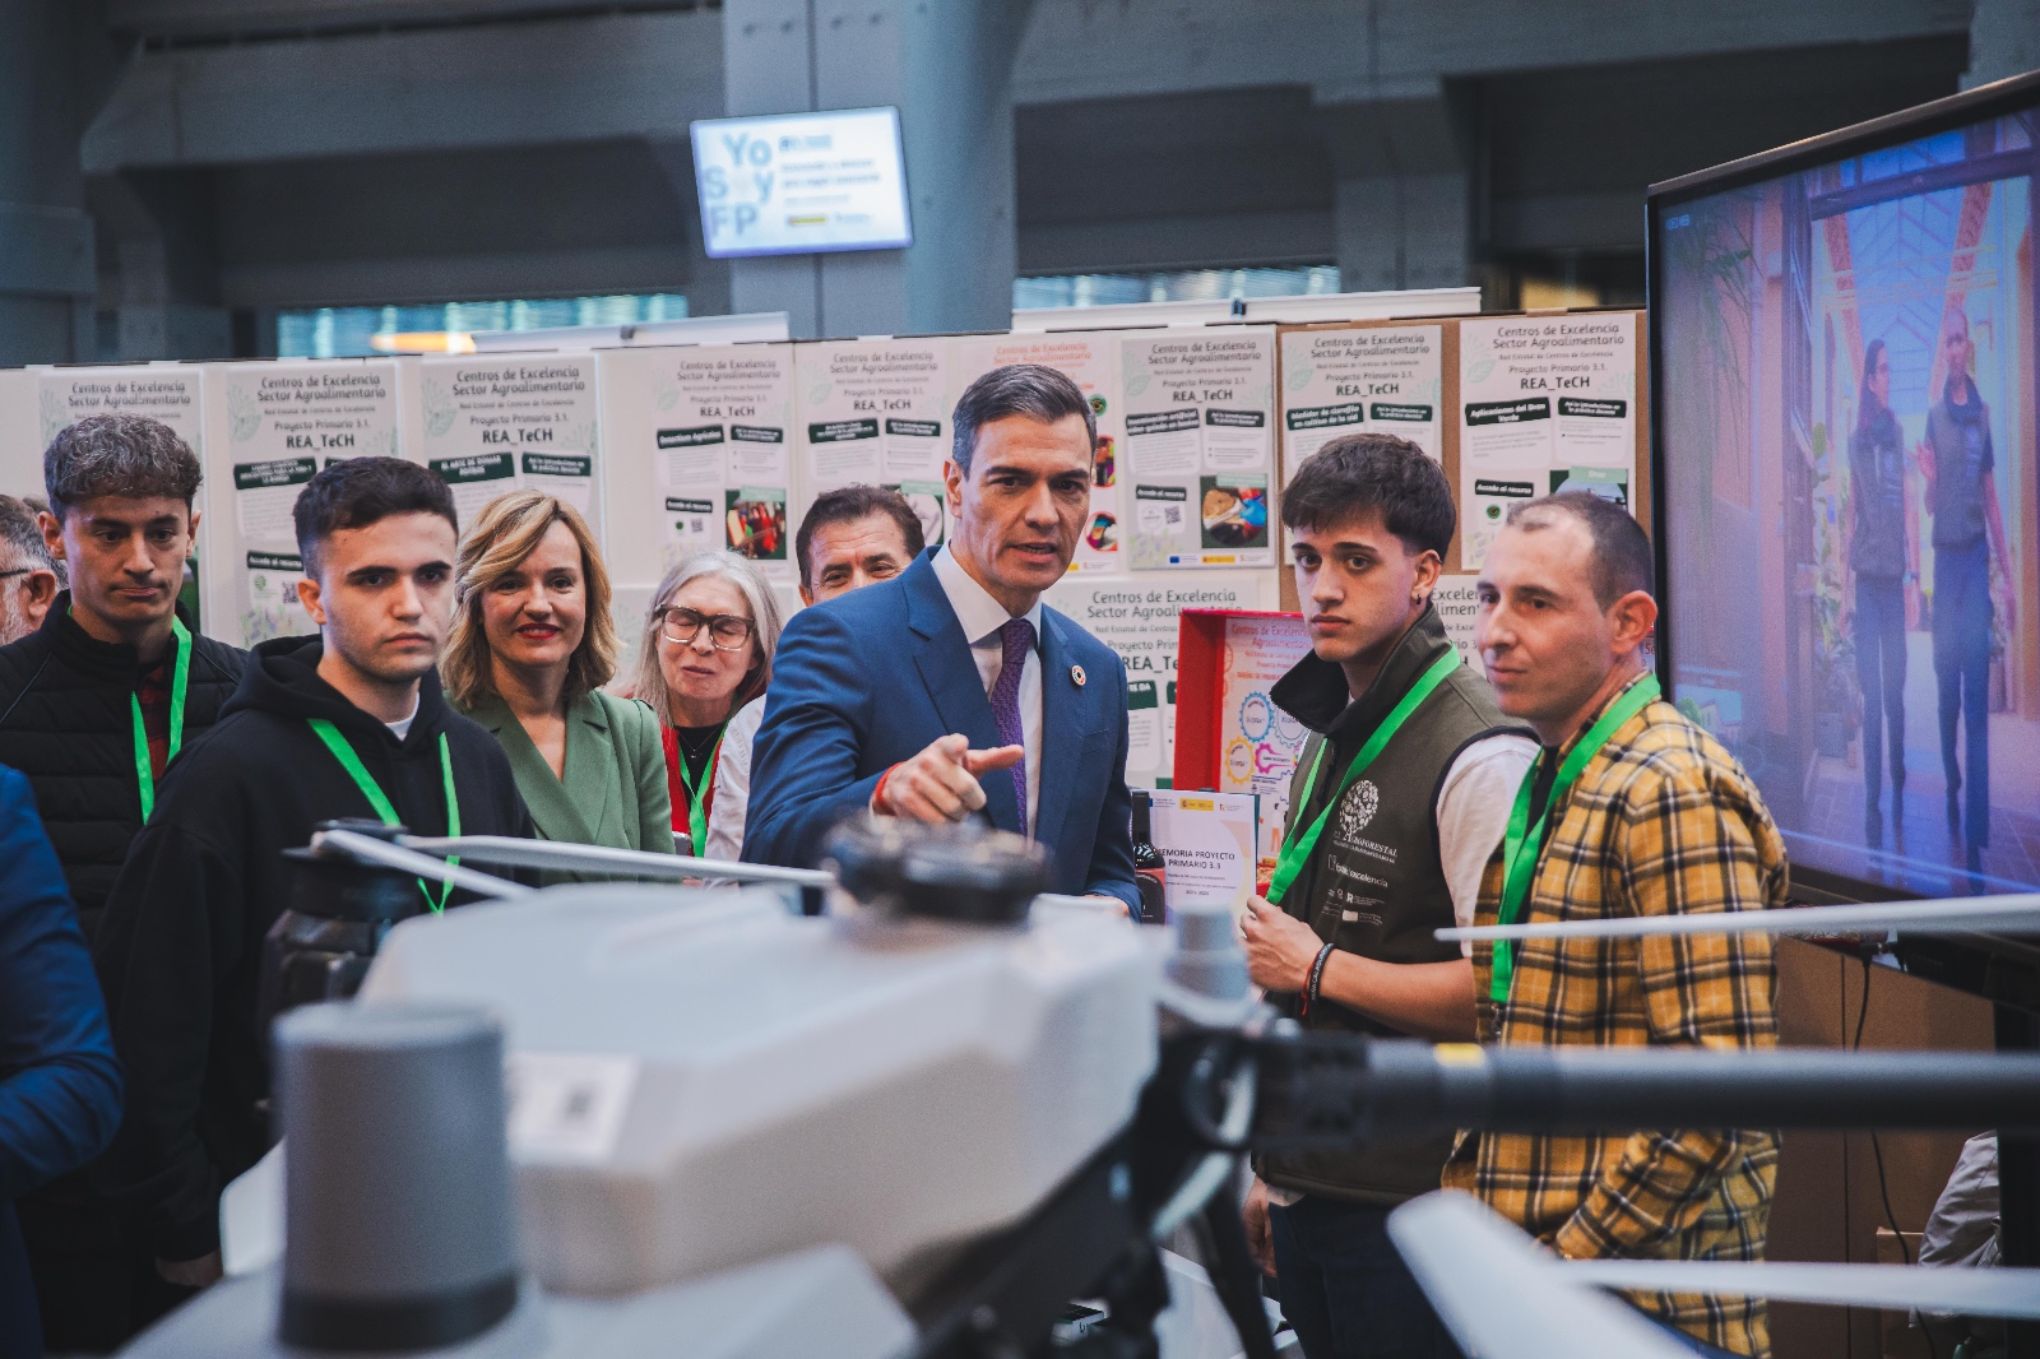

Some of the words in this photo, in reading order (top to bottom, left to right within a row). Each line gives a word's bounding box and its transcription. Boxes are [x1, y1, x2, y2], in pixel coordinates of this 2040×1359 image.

[723, 134, 772, 167] Yo
[711, 203, 758, 236] FP
[1498, 327, 1539, 337] Centros
[1543, 325, 1556, 335] de
[1561, 323, 1619, 334] Excelencia
[1152, 344, 1188, 353] Centros
[1191, 343, 1202, 352] de
[1206, 341, 1256, 351] Excelencia
[1315, 338, 1353, 348] Centros
[1356, 336, 1368, 346] de
[1372, 335, 1424, 344] Excelencia
[1493, 339, 1527, 349] Sector
[1531, 336, 1624, 350] Agroalimentario
[834, 353, 868, 363] Centros
[872, 352, 881, 361] de
[886, 351, 933, 361] Excelencia
[1148, 356, 1177, 364] Sector
[1311, 350, 1341, 358] Sector
[681, 361, 713, 370] Centros
[717, 360, 726, 369] de
[730, 359, 776, 369] Excelencia
[830, 365, 858, 373] Sector
[1509, 365, 1547, 375] Proyecto
[1552, 364, 1590, 372] Primario
[457, 370, 499, 382] Centros
[503, 369, 515, 380] de
[521, 366, 579, 379] Excelencia
[677, 372, 704, 380] Sector
[72, 382, 112, 394] Centros
[115, 382, 127, 392] de
[131, 380, 185, 392] Excelencia
[262, 376, 302, 389] Centros
[307, 376, 319, 387] de
[323, 374, 380, 386] Excelencia
[1521, 376, 1590, 391] REA_TeCH
[257, 390, 290, 401] Sector
[295, 387, 386, 403] Agroalimentario
[453, 384, 487, 396] Sector
[491, 380, 585, 397] Agroalimentario
[1336, 384, 1399, 397] REA_TeCH
[68, 395, 99, 407] Sector
[1173, 390, 1232, 403] REA_TeCH
[854, 400, 911, 412] REA_TeCH
[700, 407, 755, 419] REA_TeCH
[286, 434, 355, 451] REA_TeCH
[483, 429, 553, 445] REA_TeCH
[1093, 592, 1142, 604] Centros
[1147, 591, 1162, 603] de
[1167, 590, 1236, 602] Excelencia
[1088, 608, 1127, 618] Sector
[1107, 640, 1154, 653] Proyecto
[1195, 850, 1235, 860] PROYECTO
[1169, 860, 1207, 869] PRIMARIO
